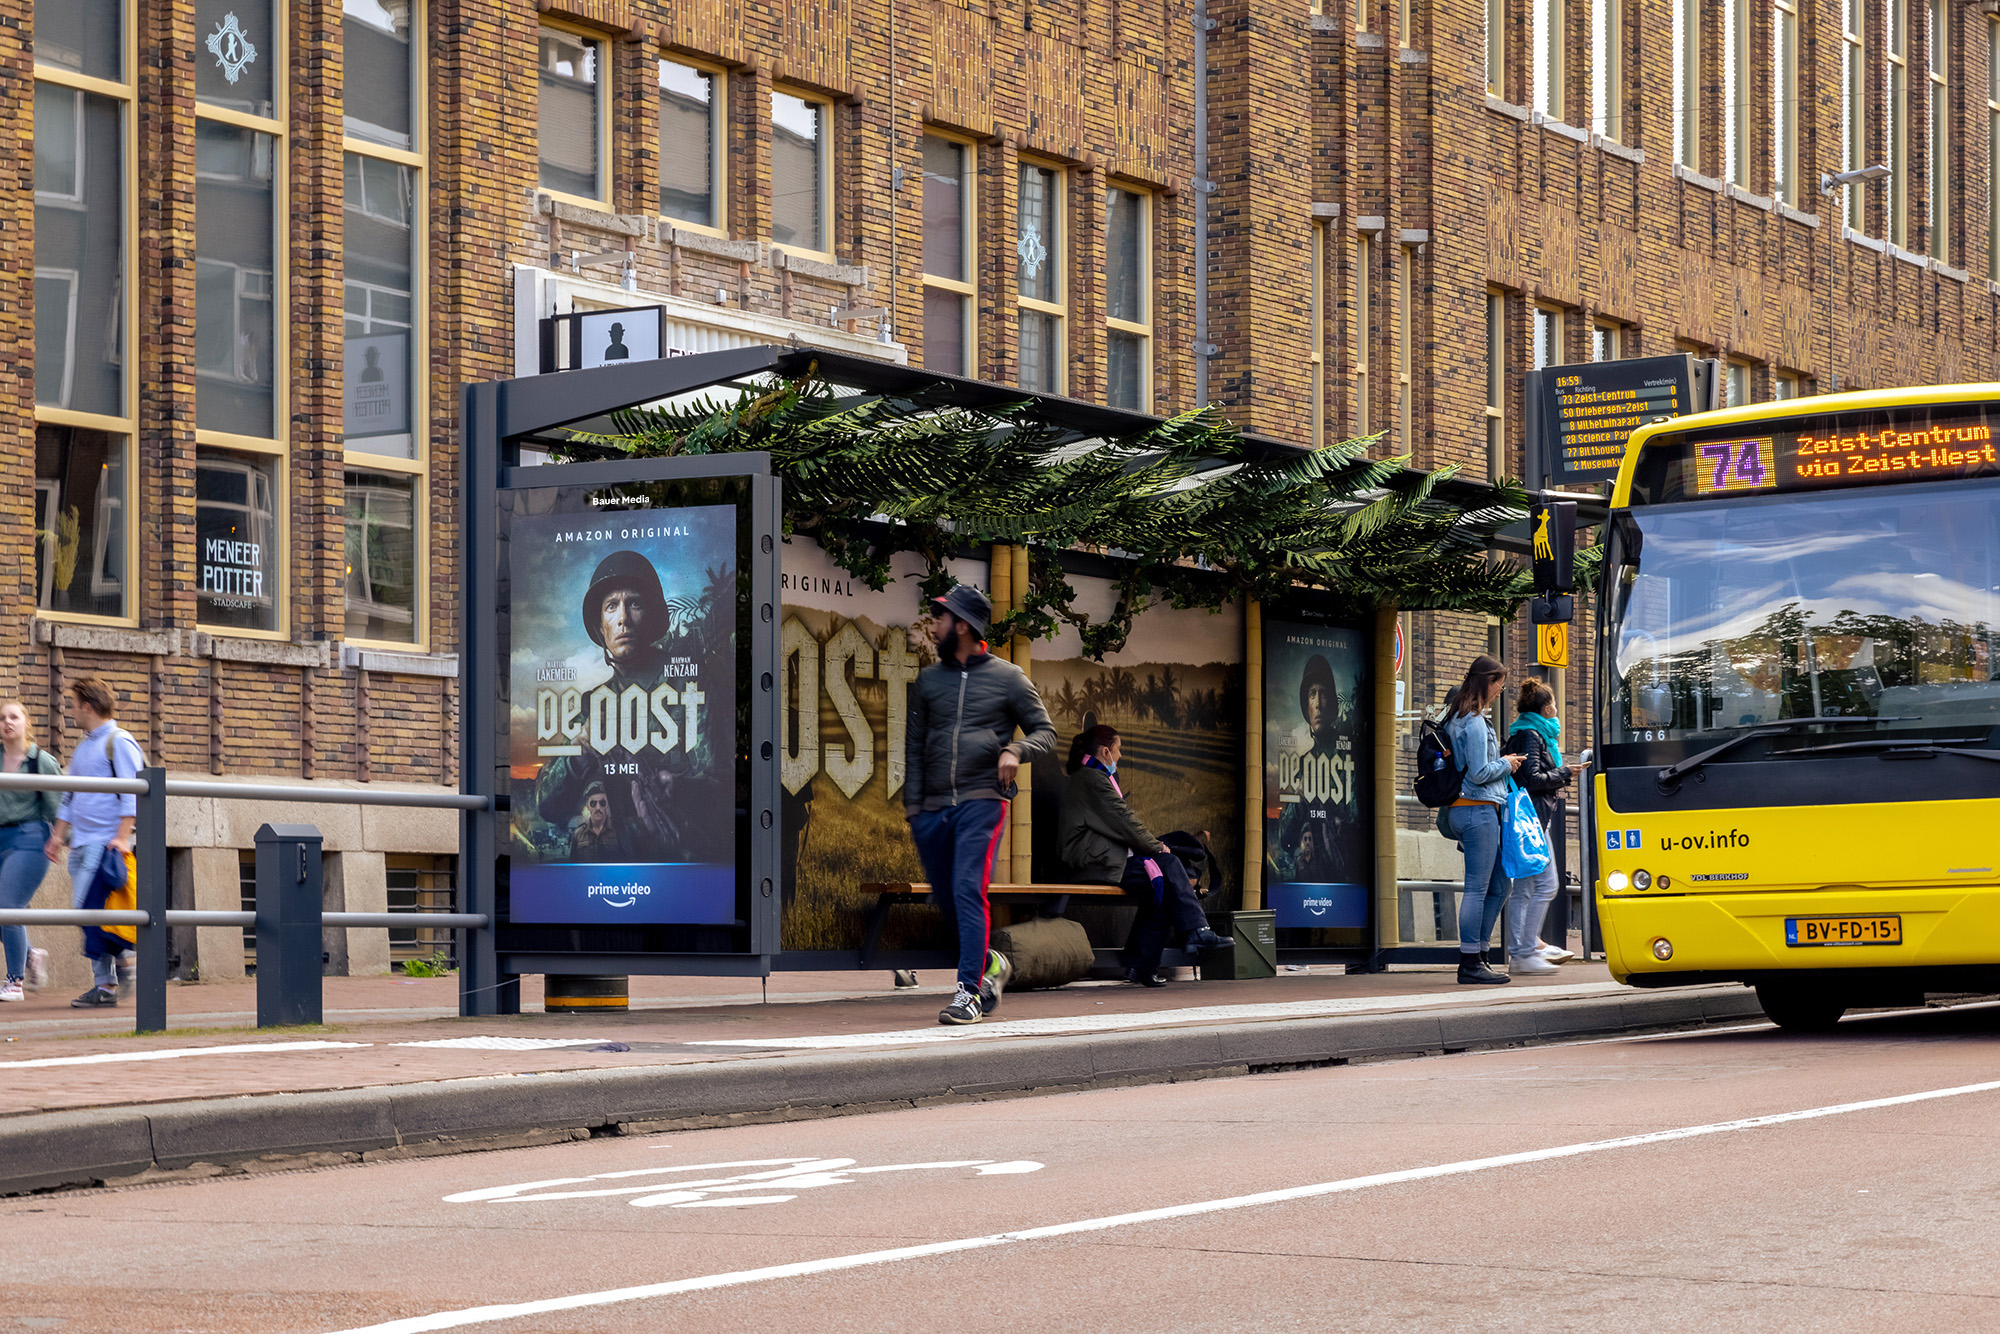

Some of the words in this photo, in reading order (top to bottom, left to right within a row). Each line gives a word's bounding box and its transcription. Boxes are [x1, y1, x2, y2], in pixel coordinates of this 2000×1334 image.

[1557, 375, 1579, 387] 16:59
[1562, 395, 1573, 405] 73
[1574, 390, 1636, 404] Zeist-Centrum
[1670, 385, 1676, 395] 0
[1574, 385, 1596, 394] Richting
[1563, 407, 1574, 418] 50
[1575, 401, 1649, 417] Driebergen-Zeist
[1671, 398, 1678, 409] 0
[1569, 421, 1575, 431] 8
[1576, 415, 1641, 428] Wilhelminapark
[1566, 434, 1576, 445] 28
[1578, 432, 1611, 444] Science
[1567, 447, 1577, 458] 77
[1579, 445, 1621, 457] Bilthoven
[1702, 441, 1766, 489] 74
[1797, 425, 1991, 456] Zeist-Centrum
[1573, 460, 1579, 471] 2
[1796, 459, 1841, 477] via
[1847, 444, 1996, 474] Zeist-West
[592, 497, 620, 506] Bauer
[621, 495, 650, 505] Media
[555, 530, 613, 543] AMAZON
[621, 526, 690, 539] ORIGINAL
[206, 538, 260, 566] MENEER
[203, 565, 262, 598] POTTER
[781, 573, 853, 597] RIGINAL
[1286, 635, 1313, 646] AMAZON
[1316, 638, 1347, 649] ORIGINAL
[663, 663, 698, 677] KENZARI
[604, 763, 616, 775] 13
[619, 763, 639, 775] MEI
[1309, 809, 1316, 818] 13
[1317, 810, 1327, 819] MEI
[1661, 829, 1750, 851] u-ov.info
[1690, 874, 1707, 882] VDL
[1709, 873, 1749, 881] BERKHOF
[588, 882, 619, 898] prime
[621, 882, 651, 895] video
[1303, 897, 1318, 908] prime
[1319, 897, 1333, 907] video
[1806, 920, 1891, 940] BV-FD-15
